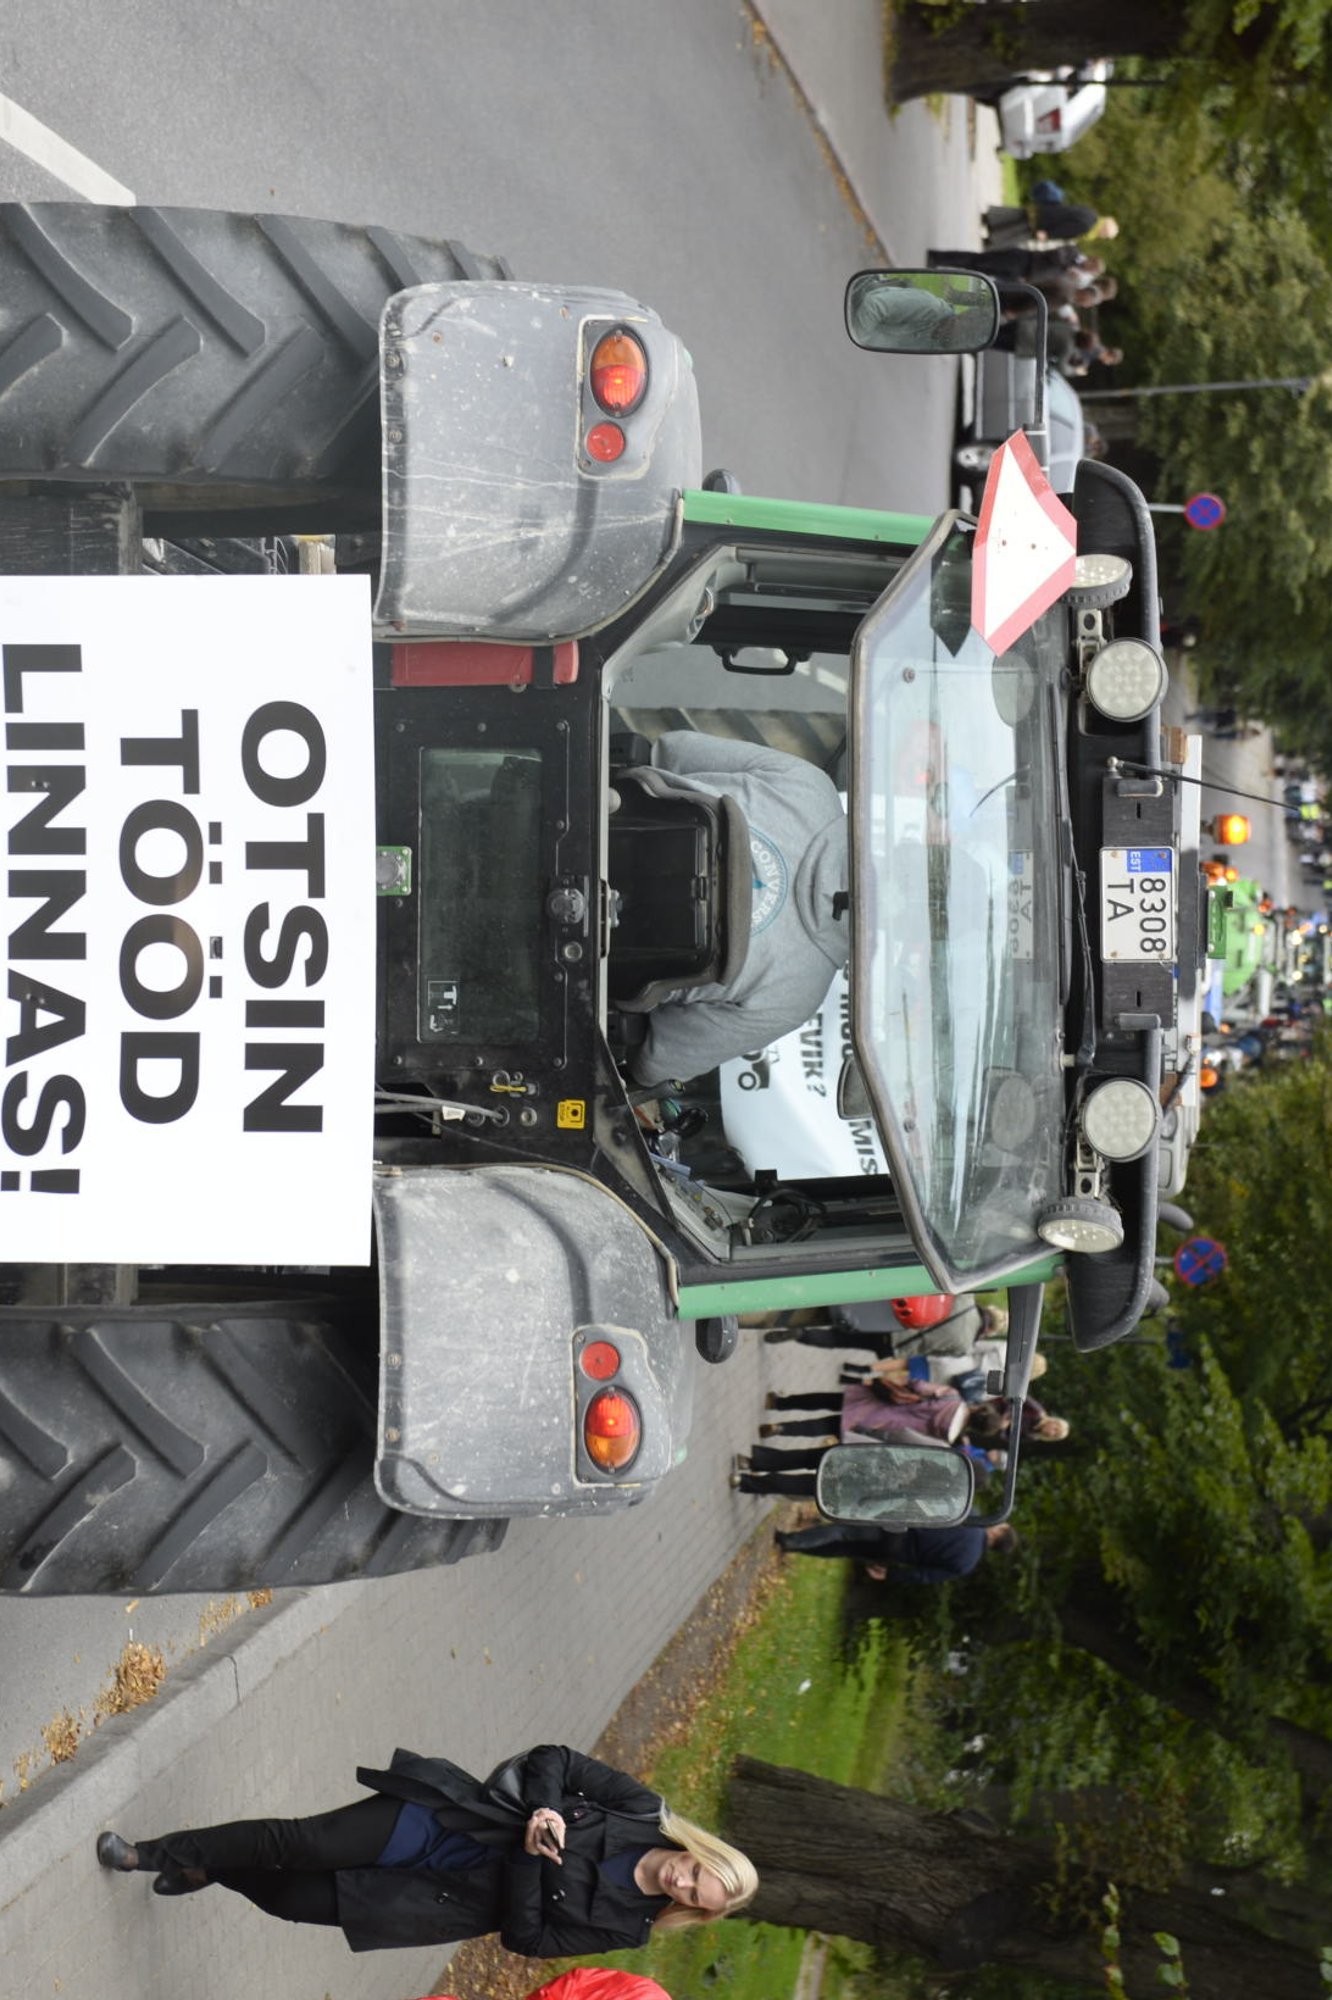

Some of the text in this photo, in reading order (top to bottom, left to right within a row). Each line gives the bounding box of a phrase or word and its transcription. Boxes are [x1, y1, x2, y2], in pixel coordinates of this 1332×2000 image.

[0, 643, 87, 1195] LINNAS!
[119, 709, 224, 1124] TÖÖD
[241, 700, 329, 1133] OTSIN
[1107, 878, 1135, 922] TA
[1130, 851, 1142, 871] EST
[1139, 878, 1167, 953] 8308
